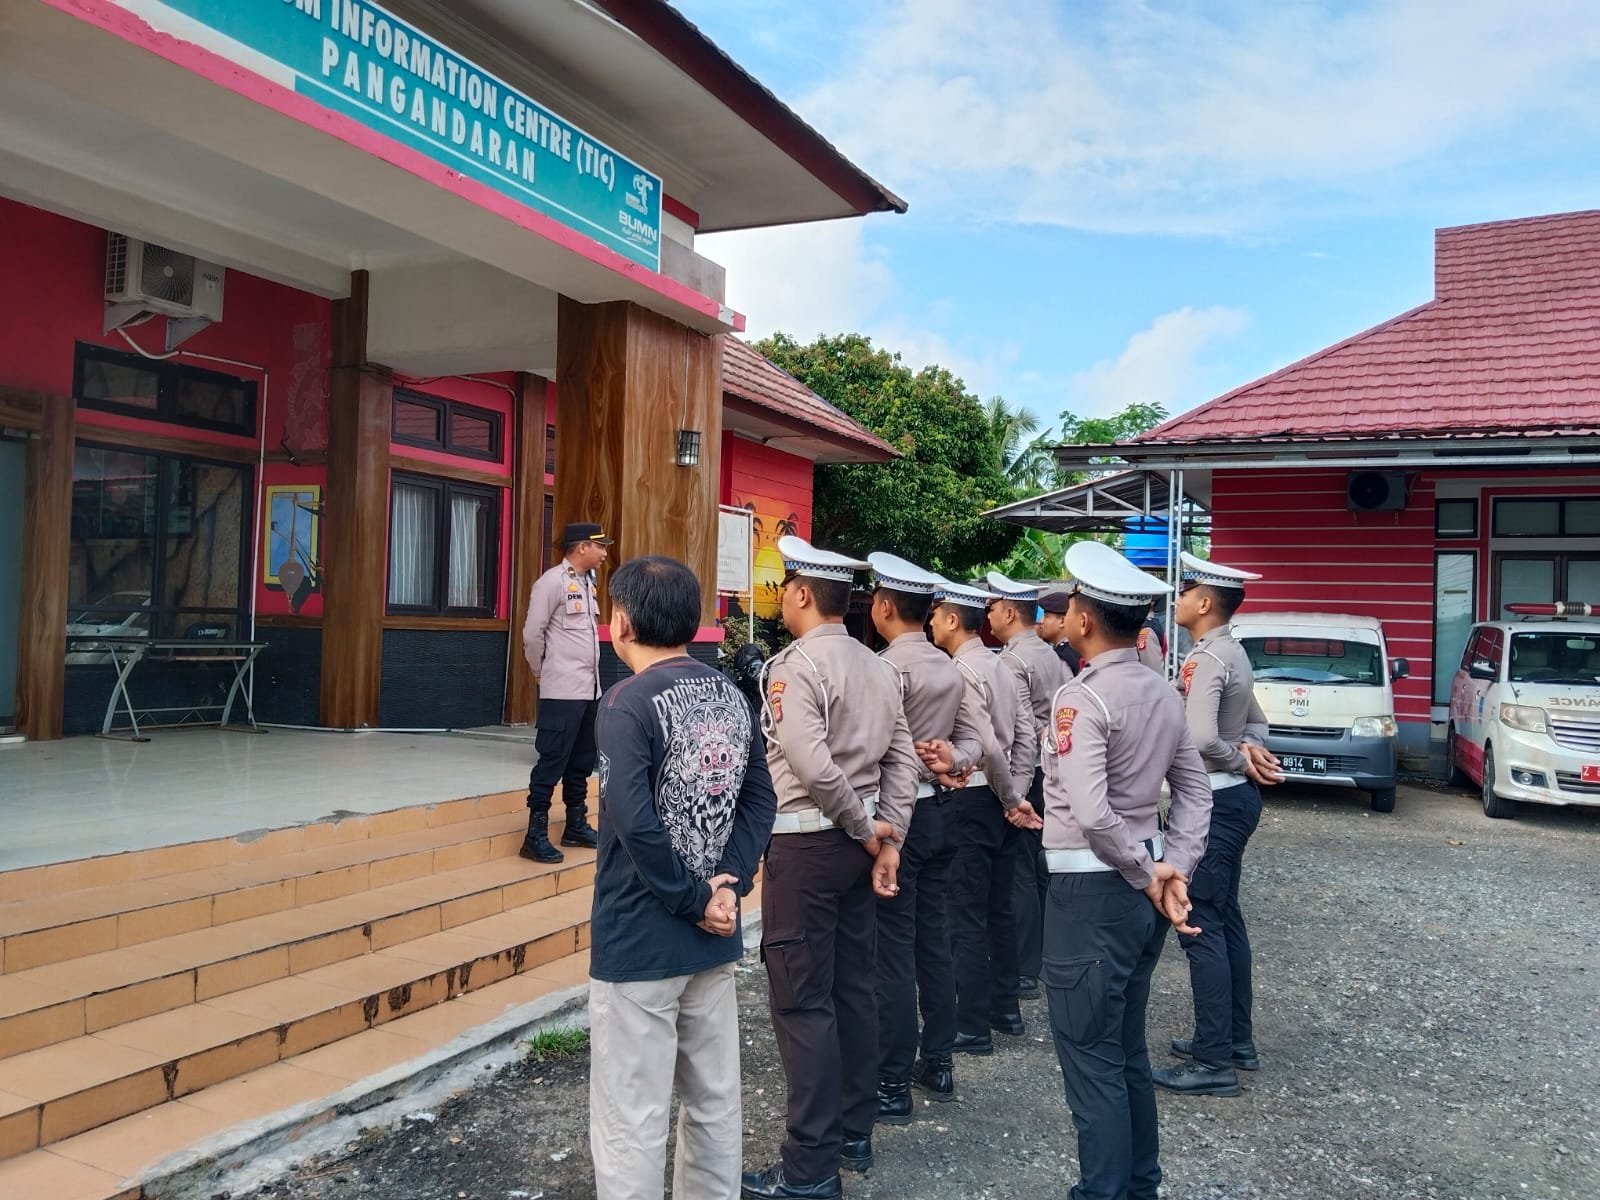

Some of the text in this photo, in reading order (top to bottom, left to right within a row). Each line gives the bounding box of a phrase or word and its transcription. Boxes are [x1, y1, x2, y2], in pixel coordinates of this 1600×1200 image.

[321, 36, 536, 184] PANGANDARAN
[331, 0, 498, 120] INFORMATION
[503, 95, 572, 163] CENTRE
[576, 137, 615, 193] (TIC)
[619, 210, 657, 242] BUMN
[1283, 757, 1303, 767] 8914
[1583, 766, 1591, 777] Z
